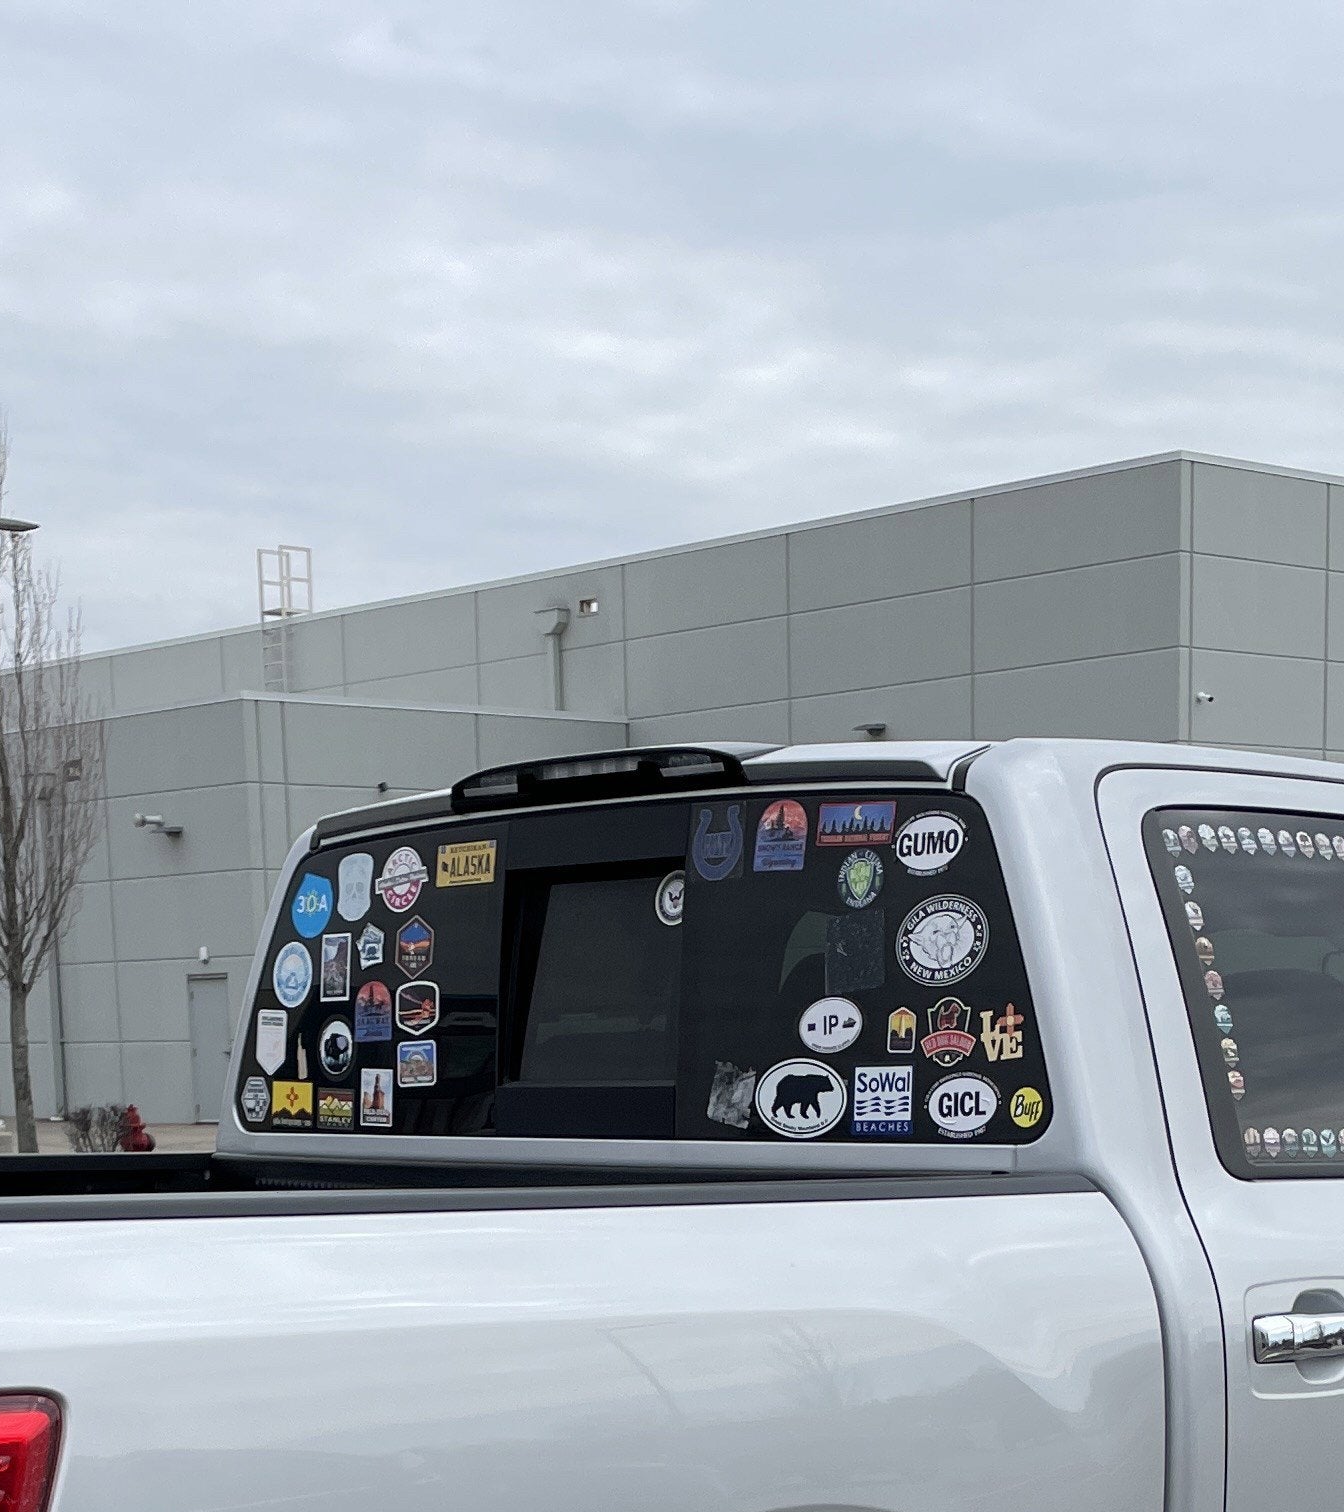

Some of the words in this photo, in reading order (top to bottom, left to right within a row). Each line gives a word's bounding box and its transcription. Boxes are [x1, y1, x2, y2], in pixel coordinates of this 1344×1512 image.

[899, 829, 959, 858] GUMO
[449, 854, 491, 877] ALASKA
[906, 909, 926, 931] GILA
[926, 900, 978, 923] WILDERNESS
[910, 961, 934, 980] NEW
[933, 956, 973, 980] MEXICO
[824, 1015, 839, 1035] IP
[857, 1071, 910, 1093] SoWal
[938, 1091, 986, 1118] GICL
[856, 1122, 909, 1132] BEACHES
